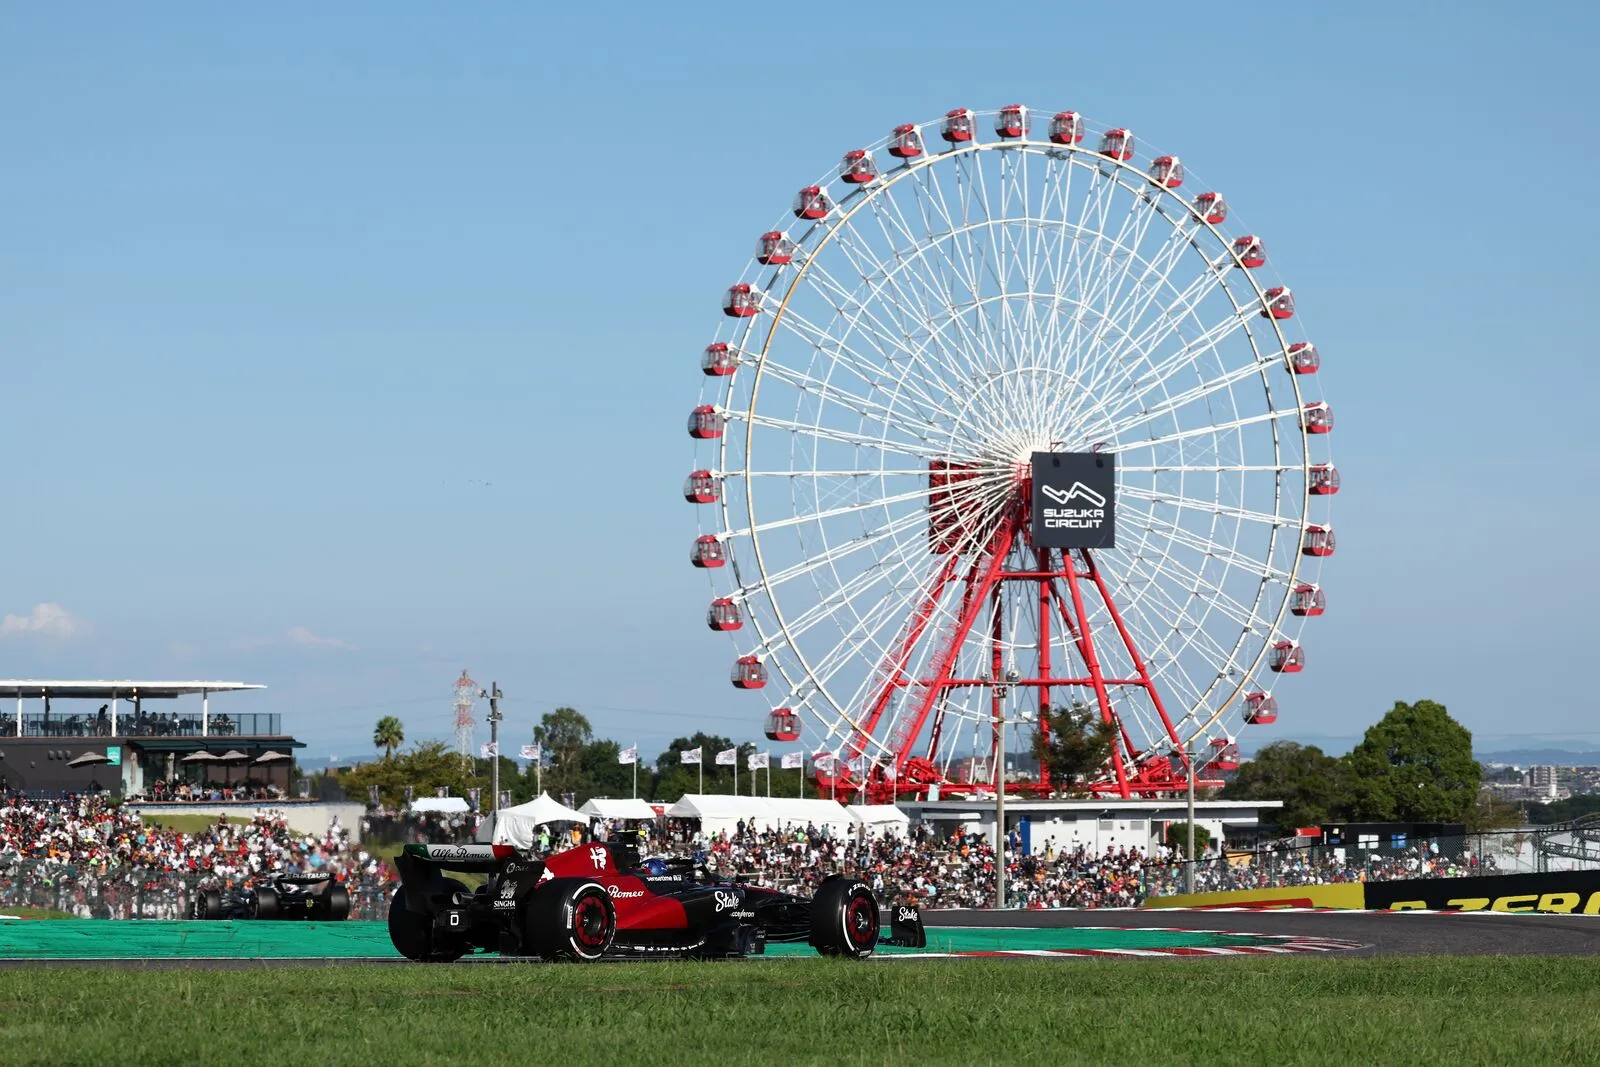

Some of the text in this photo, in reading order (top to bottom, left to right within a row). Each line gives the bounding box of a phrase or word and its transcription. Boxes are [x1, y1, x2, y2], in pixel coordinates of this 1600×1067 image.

[1043, 508, 1104, 518] SUZUKA
[1044, 519, 1103, 528] CIRCUIT
[432, 847, 491, 860] Alfa Romeo
[607, 885, 644, 898] Romeo
[493, 900, 516, 908] SINGHA
[714, 890, 740, 912] Stake
[899, 906, 918, 921] Stake
